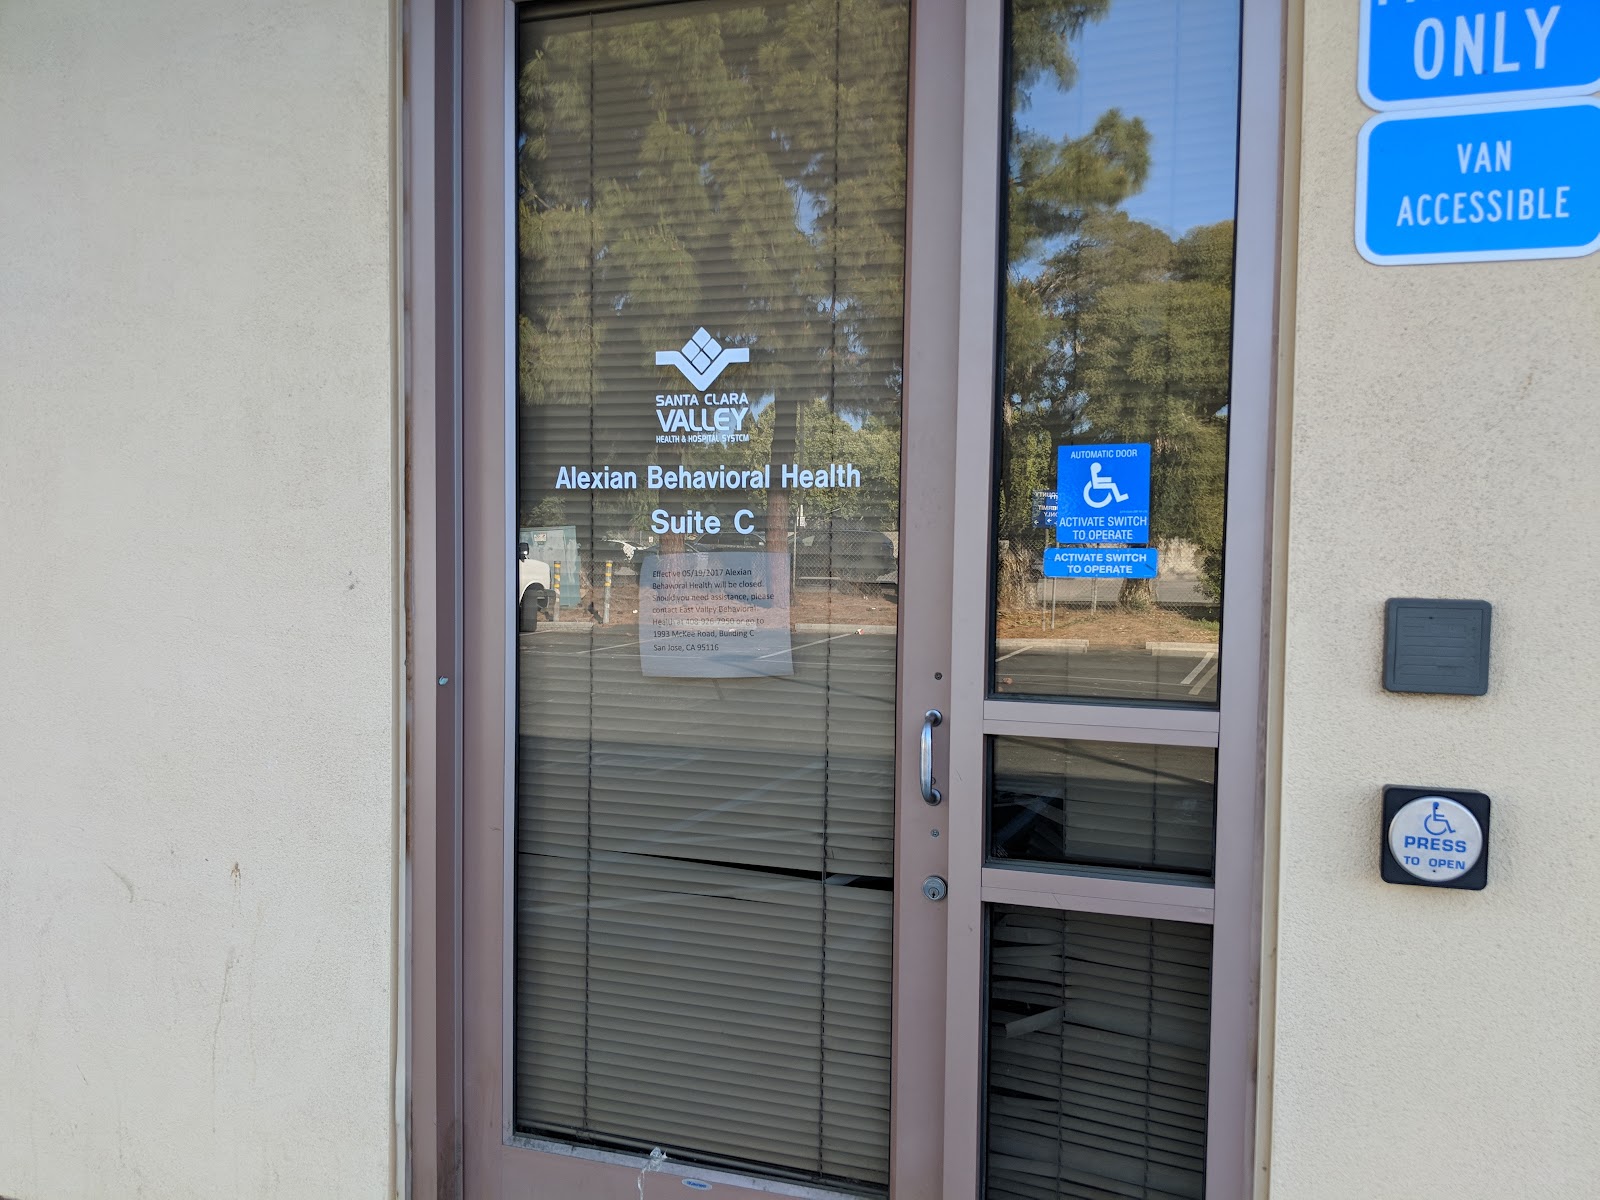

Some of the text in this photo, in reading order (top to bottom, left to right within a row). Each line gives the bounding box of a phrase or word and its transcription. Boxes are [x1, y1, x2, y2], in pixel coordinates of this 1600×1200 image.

[1413, 5, 1561, 80] ONLY
[1457, 140, 1512, 174] VAN
[1396, 186, 1570, 227] ACCESSIBLE
[655, 392, 749, 406] SANTA CLARA
[656, 407, 749, 432] VALLEY
[656, 435, 680, 443] HEALTH
[681, 435, 686, 443] &
[688, 434, 720, 443] HOSPITAL
[1070, 449, 1138, 459] AUTOMATIC DOOR
[555, 463, 861, 489] Alexian Behavioral Health
[651, 509, 755, 534] Suite C
[1059, 516, 1147, 527] ACTIVATE SWITCH
[1073, 530, 1133, 540] TO OPERATE
[1054, 554, 1147, 562] ACTIVATE SWITCH
[1067, 565, 1133, 574] TO OPERATE
[711, 593, 749, 602] assistance,
[750, 594, 775, 602] please
[695, 606, 717, 615] Valley
[745, 619, 755, 627] go
[653, 630, 670, 638] 1993
[671, 630, 696, 638] McKee
[697, 630, 717, 639] Road,
[718, 630, 748, 639] Building
[667, 644, 685, 652] Jose,
[1404, 836, 1467, 853] PRESS
[1403, 855, 1466, 870] TO OPEN
